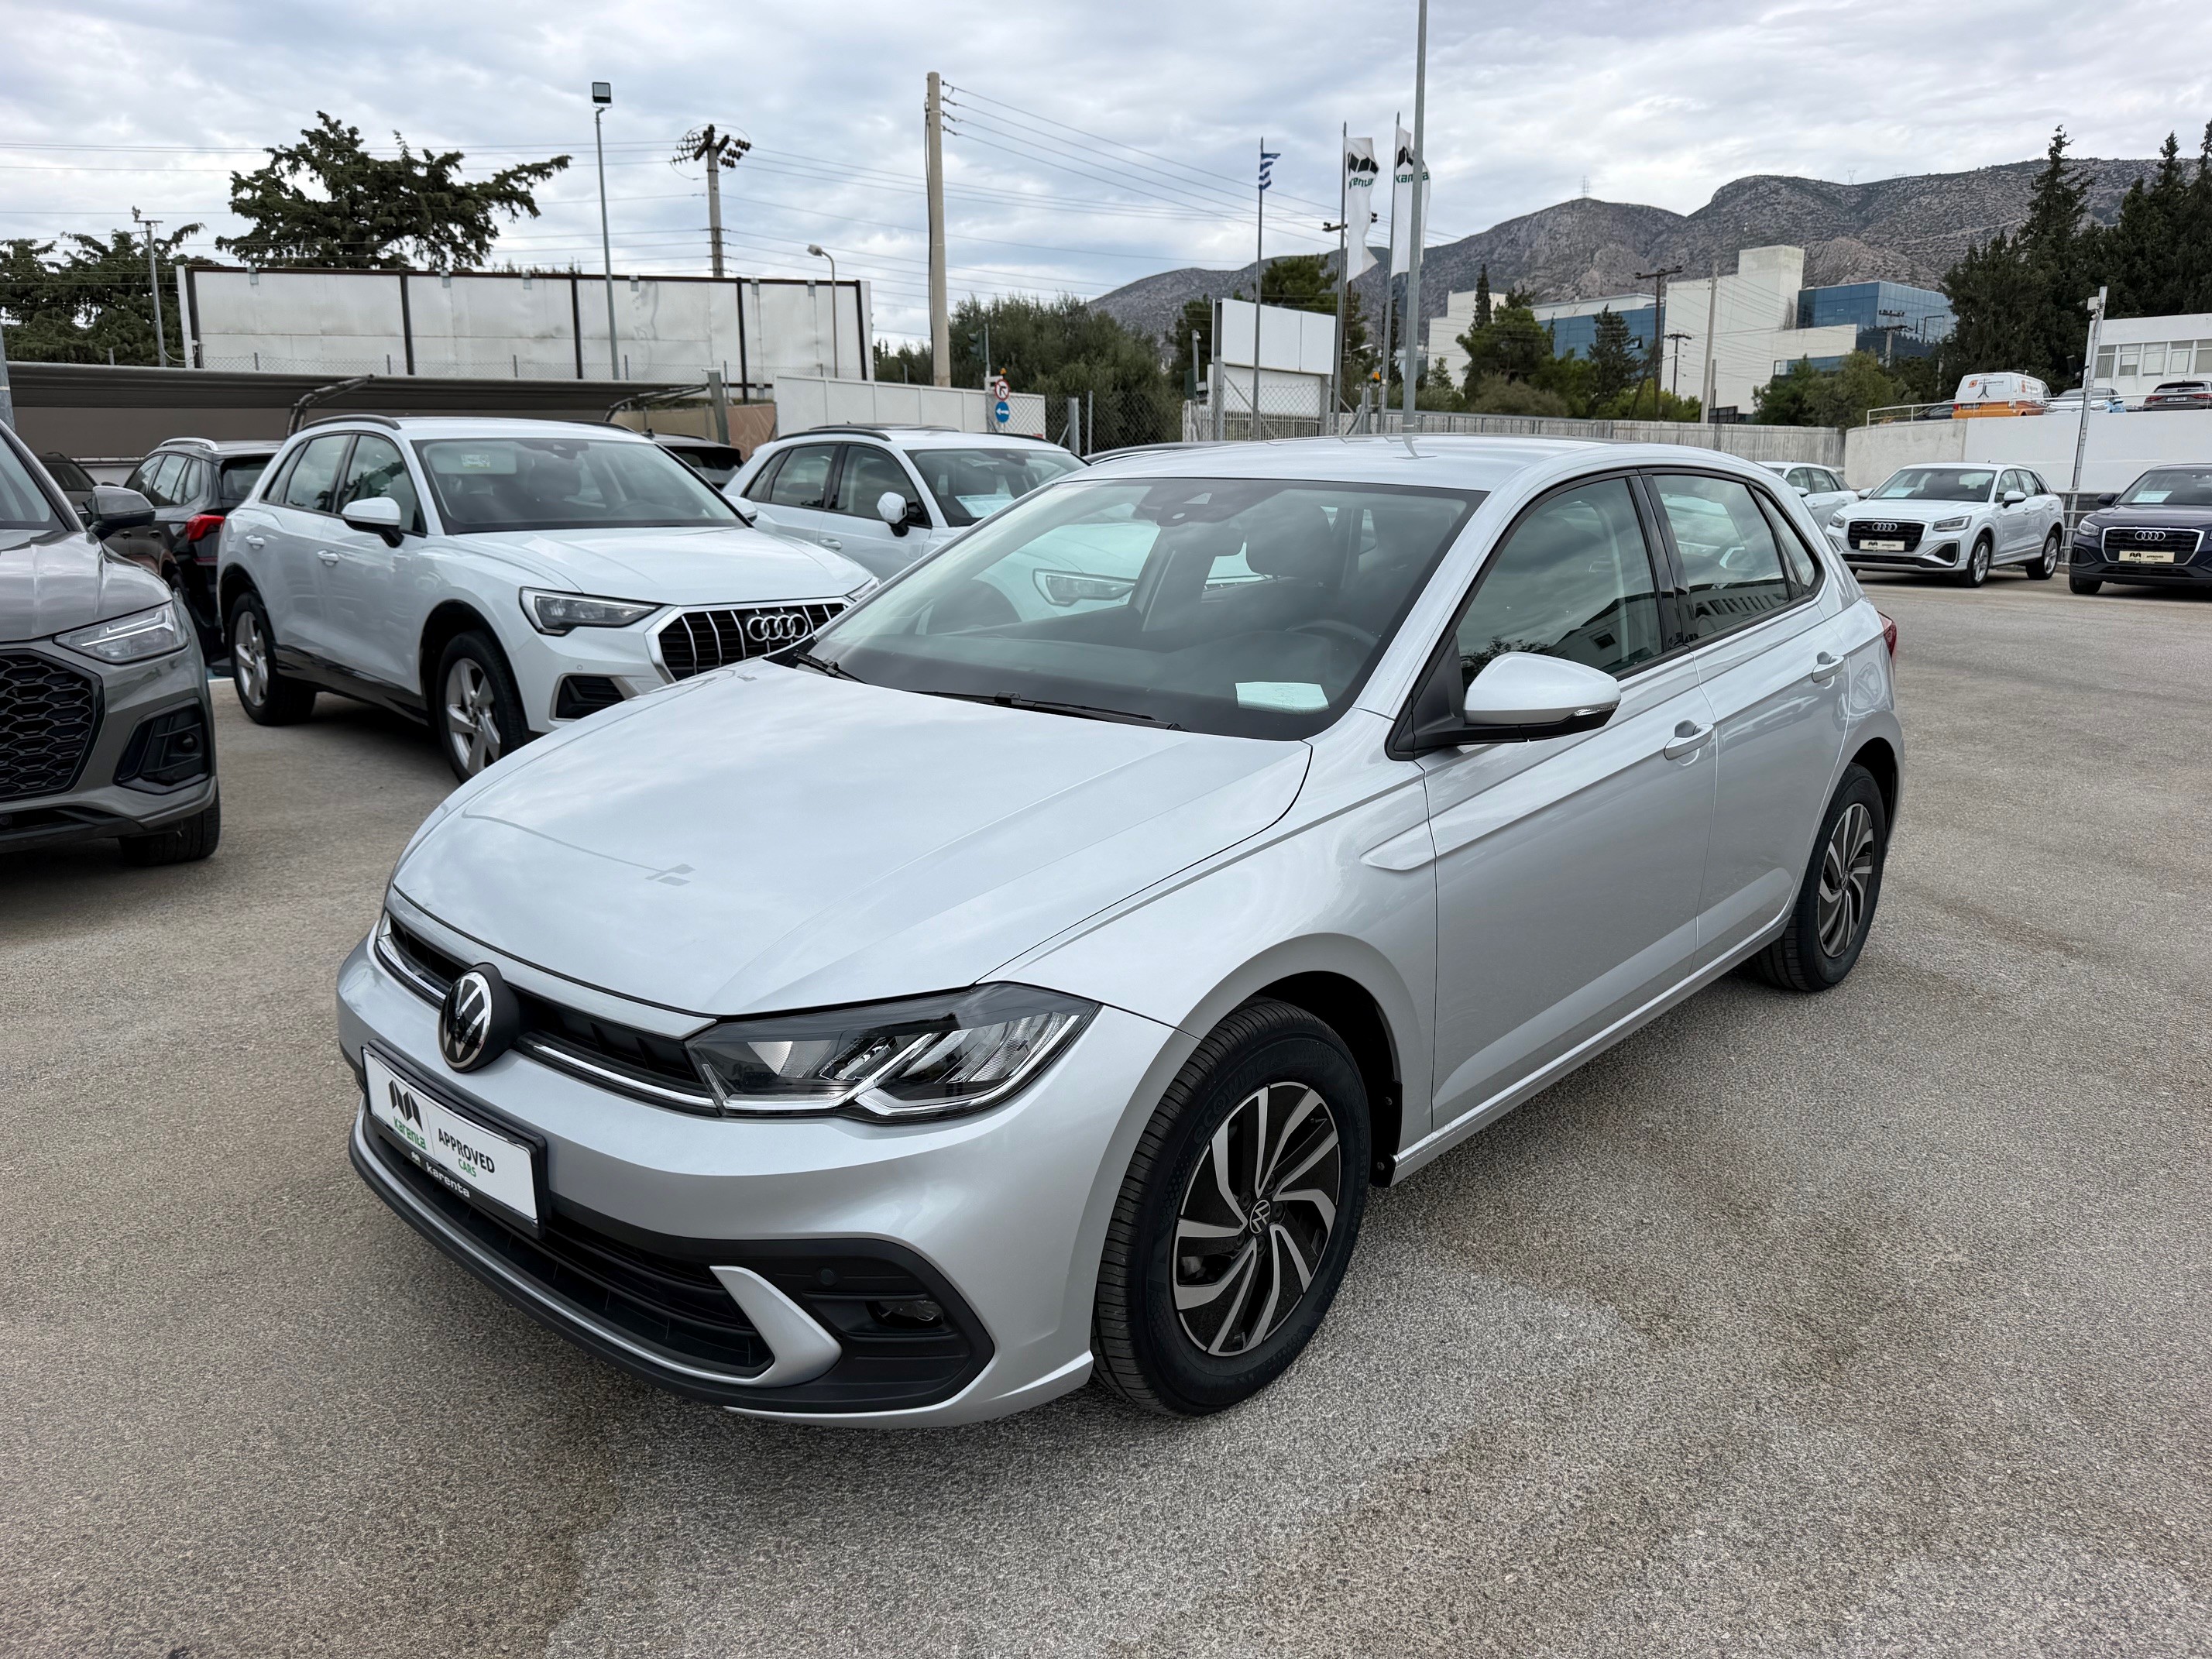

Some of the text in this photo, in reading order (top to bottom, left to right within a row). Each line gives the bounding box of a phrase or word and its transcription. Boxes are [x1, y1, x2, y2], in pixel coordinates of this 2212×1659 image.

[393, 1115, 427, 1150] karenta
[438, 1128, 495, 1173] APPROVED
[459, 1158, 477, 1177] CARS
[426, 1162, 470, 1198] karenta
